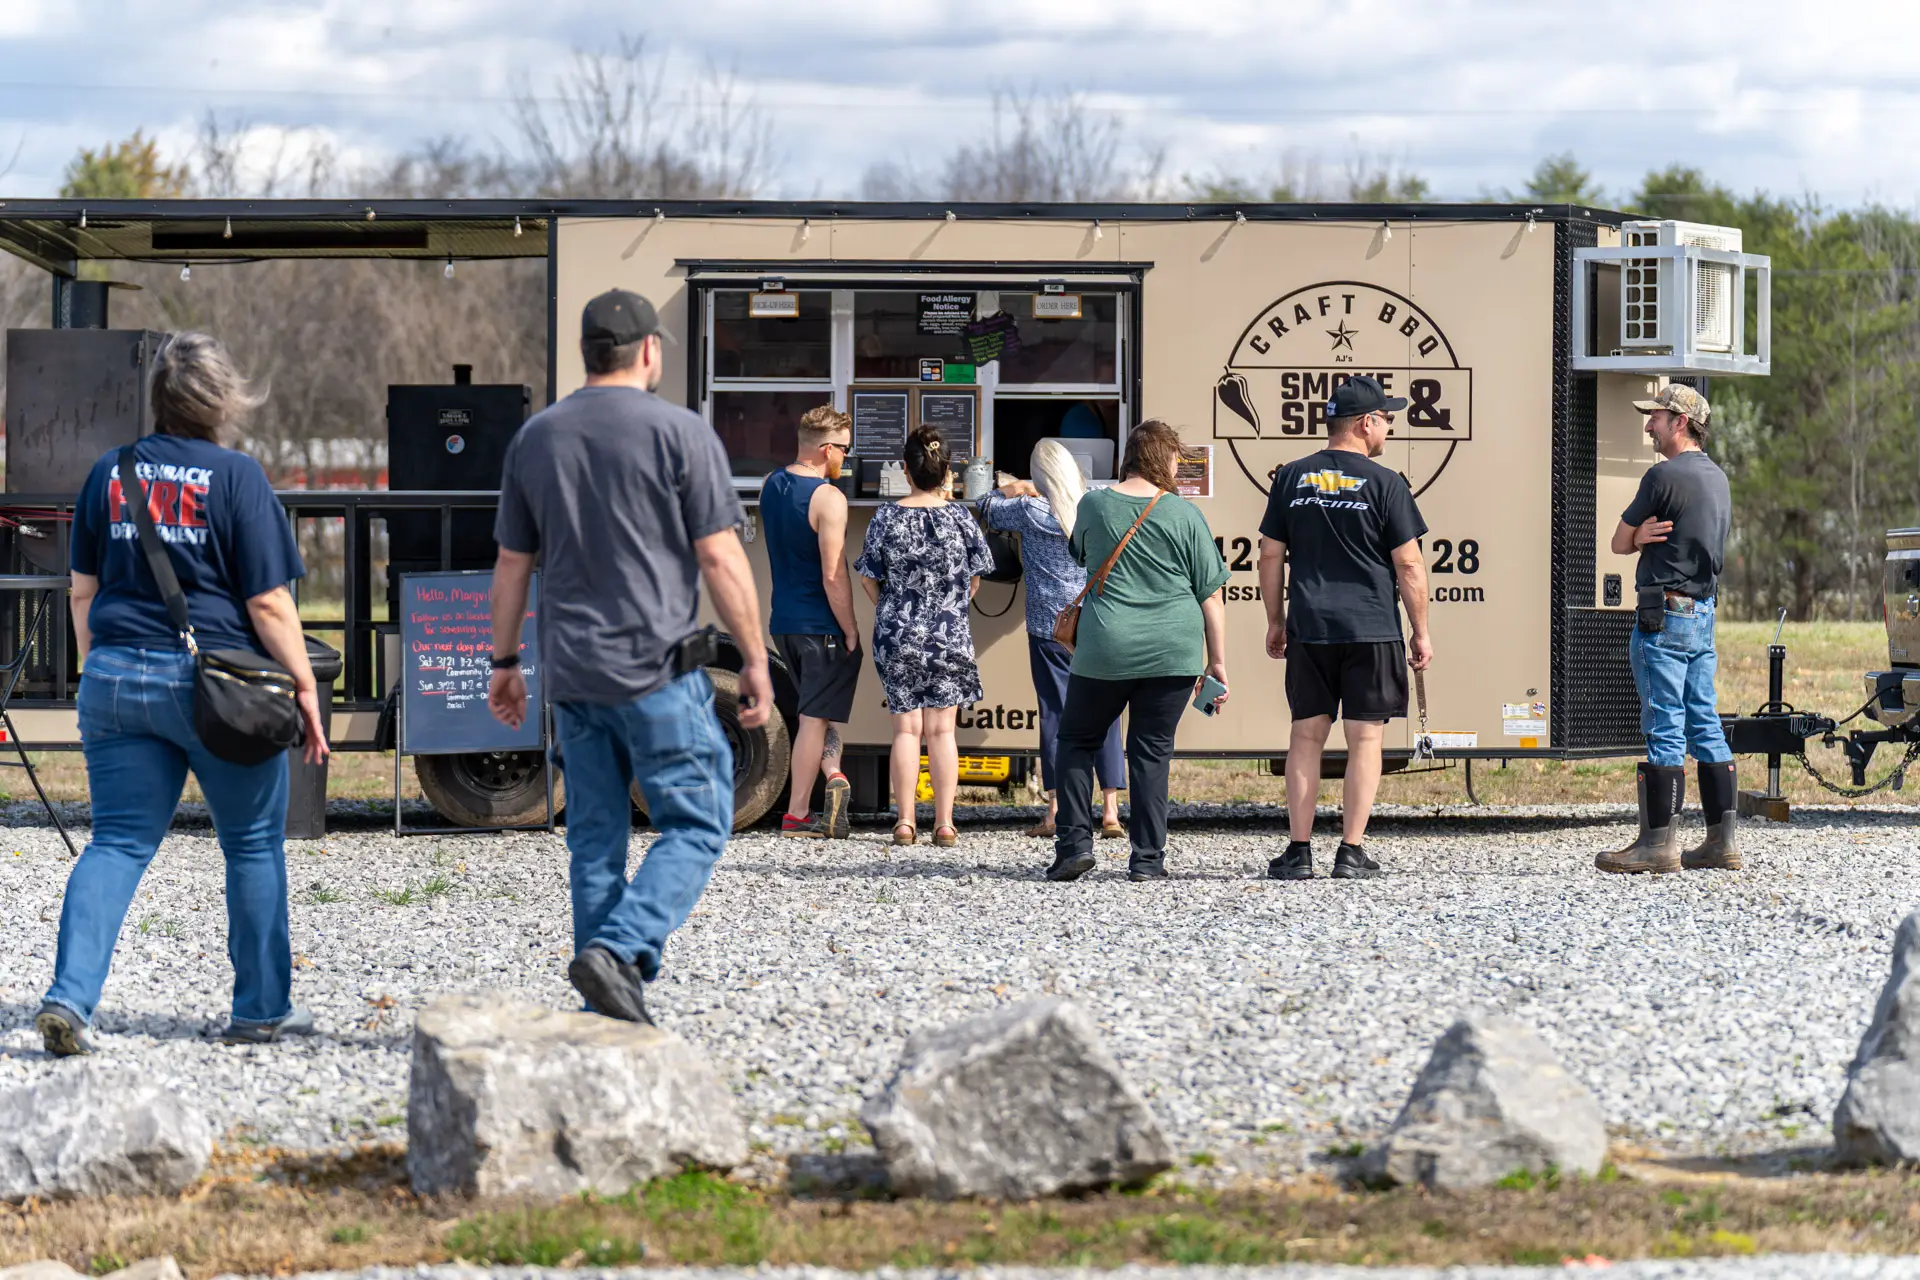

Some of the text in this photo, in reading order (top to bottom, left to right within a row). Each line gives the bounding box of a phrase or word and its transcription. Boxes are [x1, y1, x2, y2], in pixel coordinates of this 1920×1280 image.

[942, 295, 971, 303] Allergy
[1036, 301, 1077, 310] ORDER HERE
[1249, 294, 1439, 358] CRAFT BBQ
[1335, 354, 1353, 363] AJ's
[1407, 378, 1455, 430] &
[1289, 497, 1369, 510] RACING
[416, 586, 448, 603] Hello,
[412, 640, 432, 652] Our
[434, 642, 453, 651] next
[456, 641, 474, 656] day
[419, 655, 433, 667] Sat
[446, 667, 483, 680] Community
[418, 681, 434, 691] Sun
